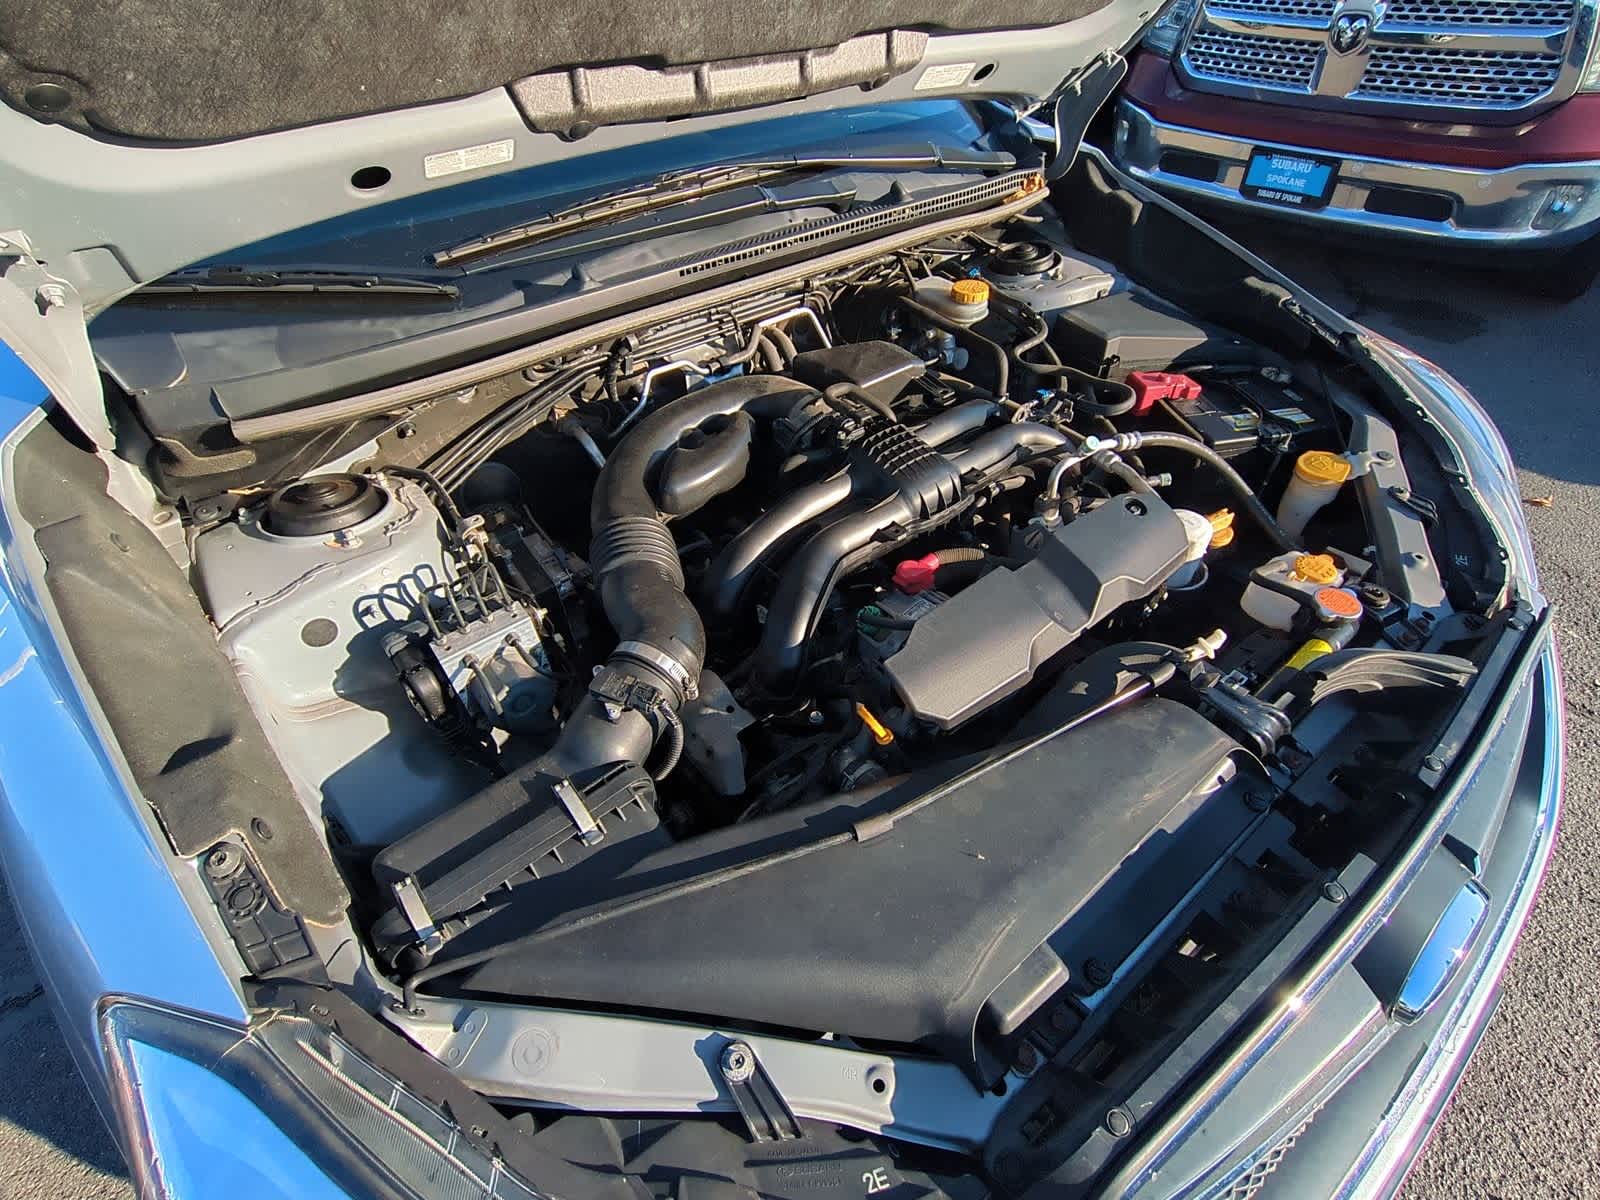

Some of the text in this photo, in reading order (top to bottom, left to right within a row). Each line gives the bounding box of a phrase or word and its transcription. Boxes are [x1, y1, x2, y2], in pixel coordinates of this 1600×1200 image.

[1271, 159, 1312, 172] SUBARU
[1266, 174, 1306, 187] SPOKANE
[1257, 189, 1274, 198] SUBARU
[1281, 192, 1303, 203] SPOKANE
[862, 1166, 890, 1194] 2E
